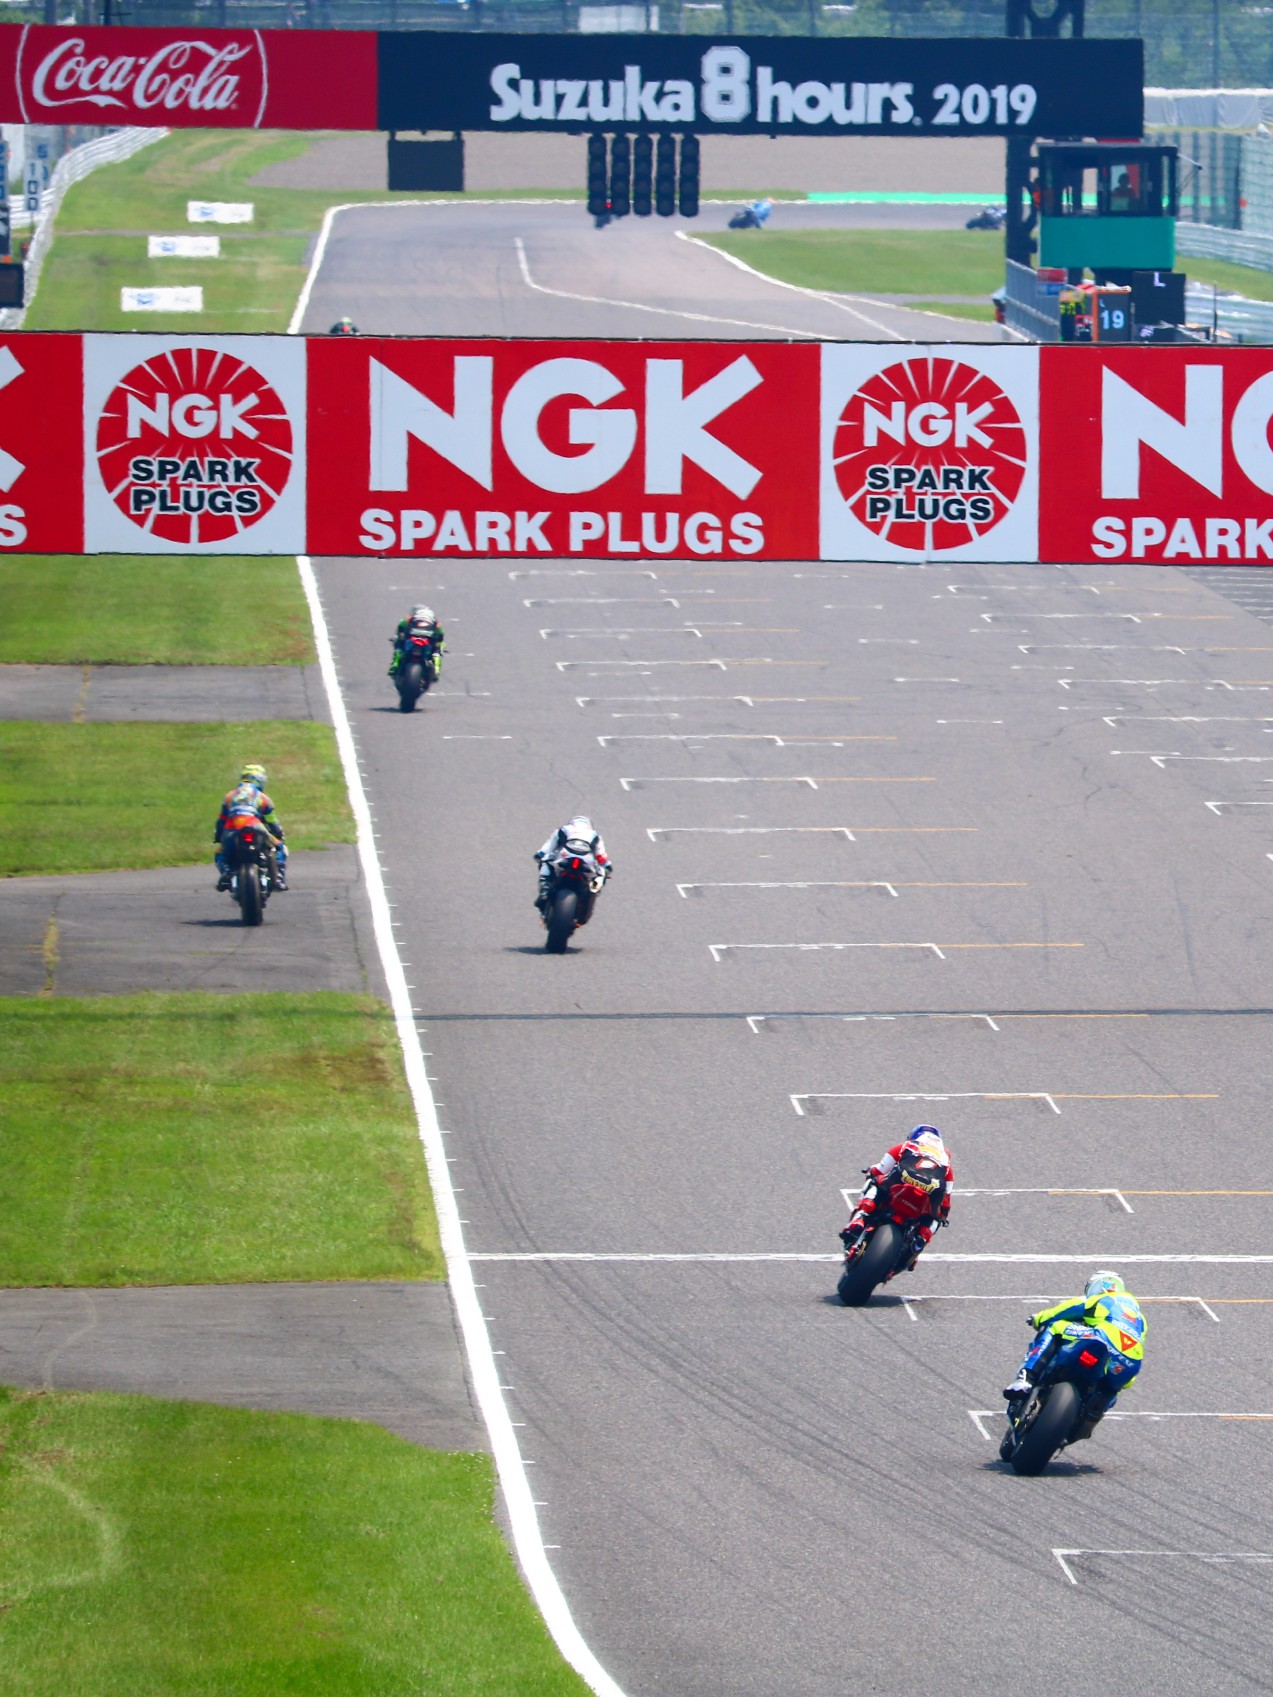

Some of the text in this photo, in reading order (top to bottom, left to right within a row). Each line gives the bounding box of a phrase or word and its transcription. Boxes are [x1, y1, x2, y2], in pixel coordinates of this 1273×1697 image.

[32, 37, 251, 110] Coca-Cola
[489, 62, 696, 123] Suzuka
[700, 45, 751, 123] 8
[931, 83, 1038, 126] 2019
[1100, 310, 1125, 330] 19
[126, 392, 260, 439] NGK
[368, 354, 764, 501] NGK
[863, 401, 994, 449] NGK
[130, 456, 260, 484] SPARK
[866, 465, 993, 493] SPARK
[130, 486, 260, 515] PLUGS
[866, 495, 993, 523] PLUGS
[359, 508, 765, 554] SPARK PLUGS
